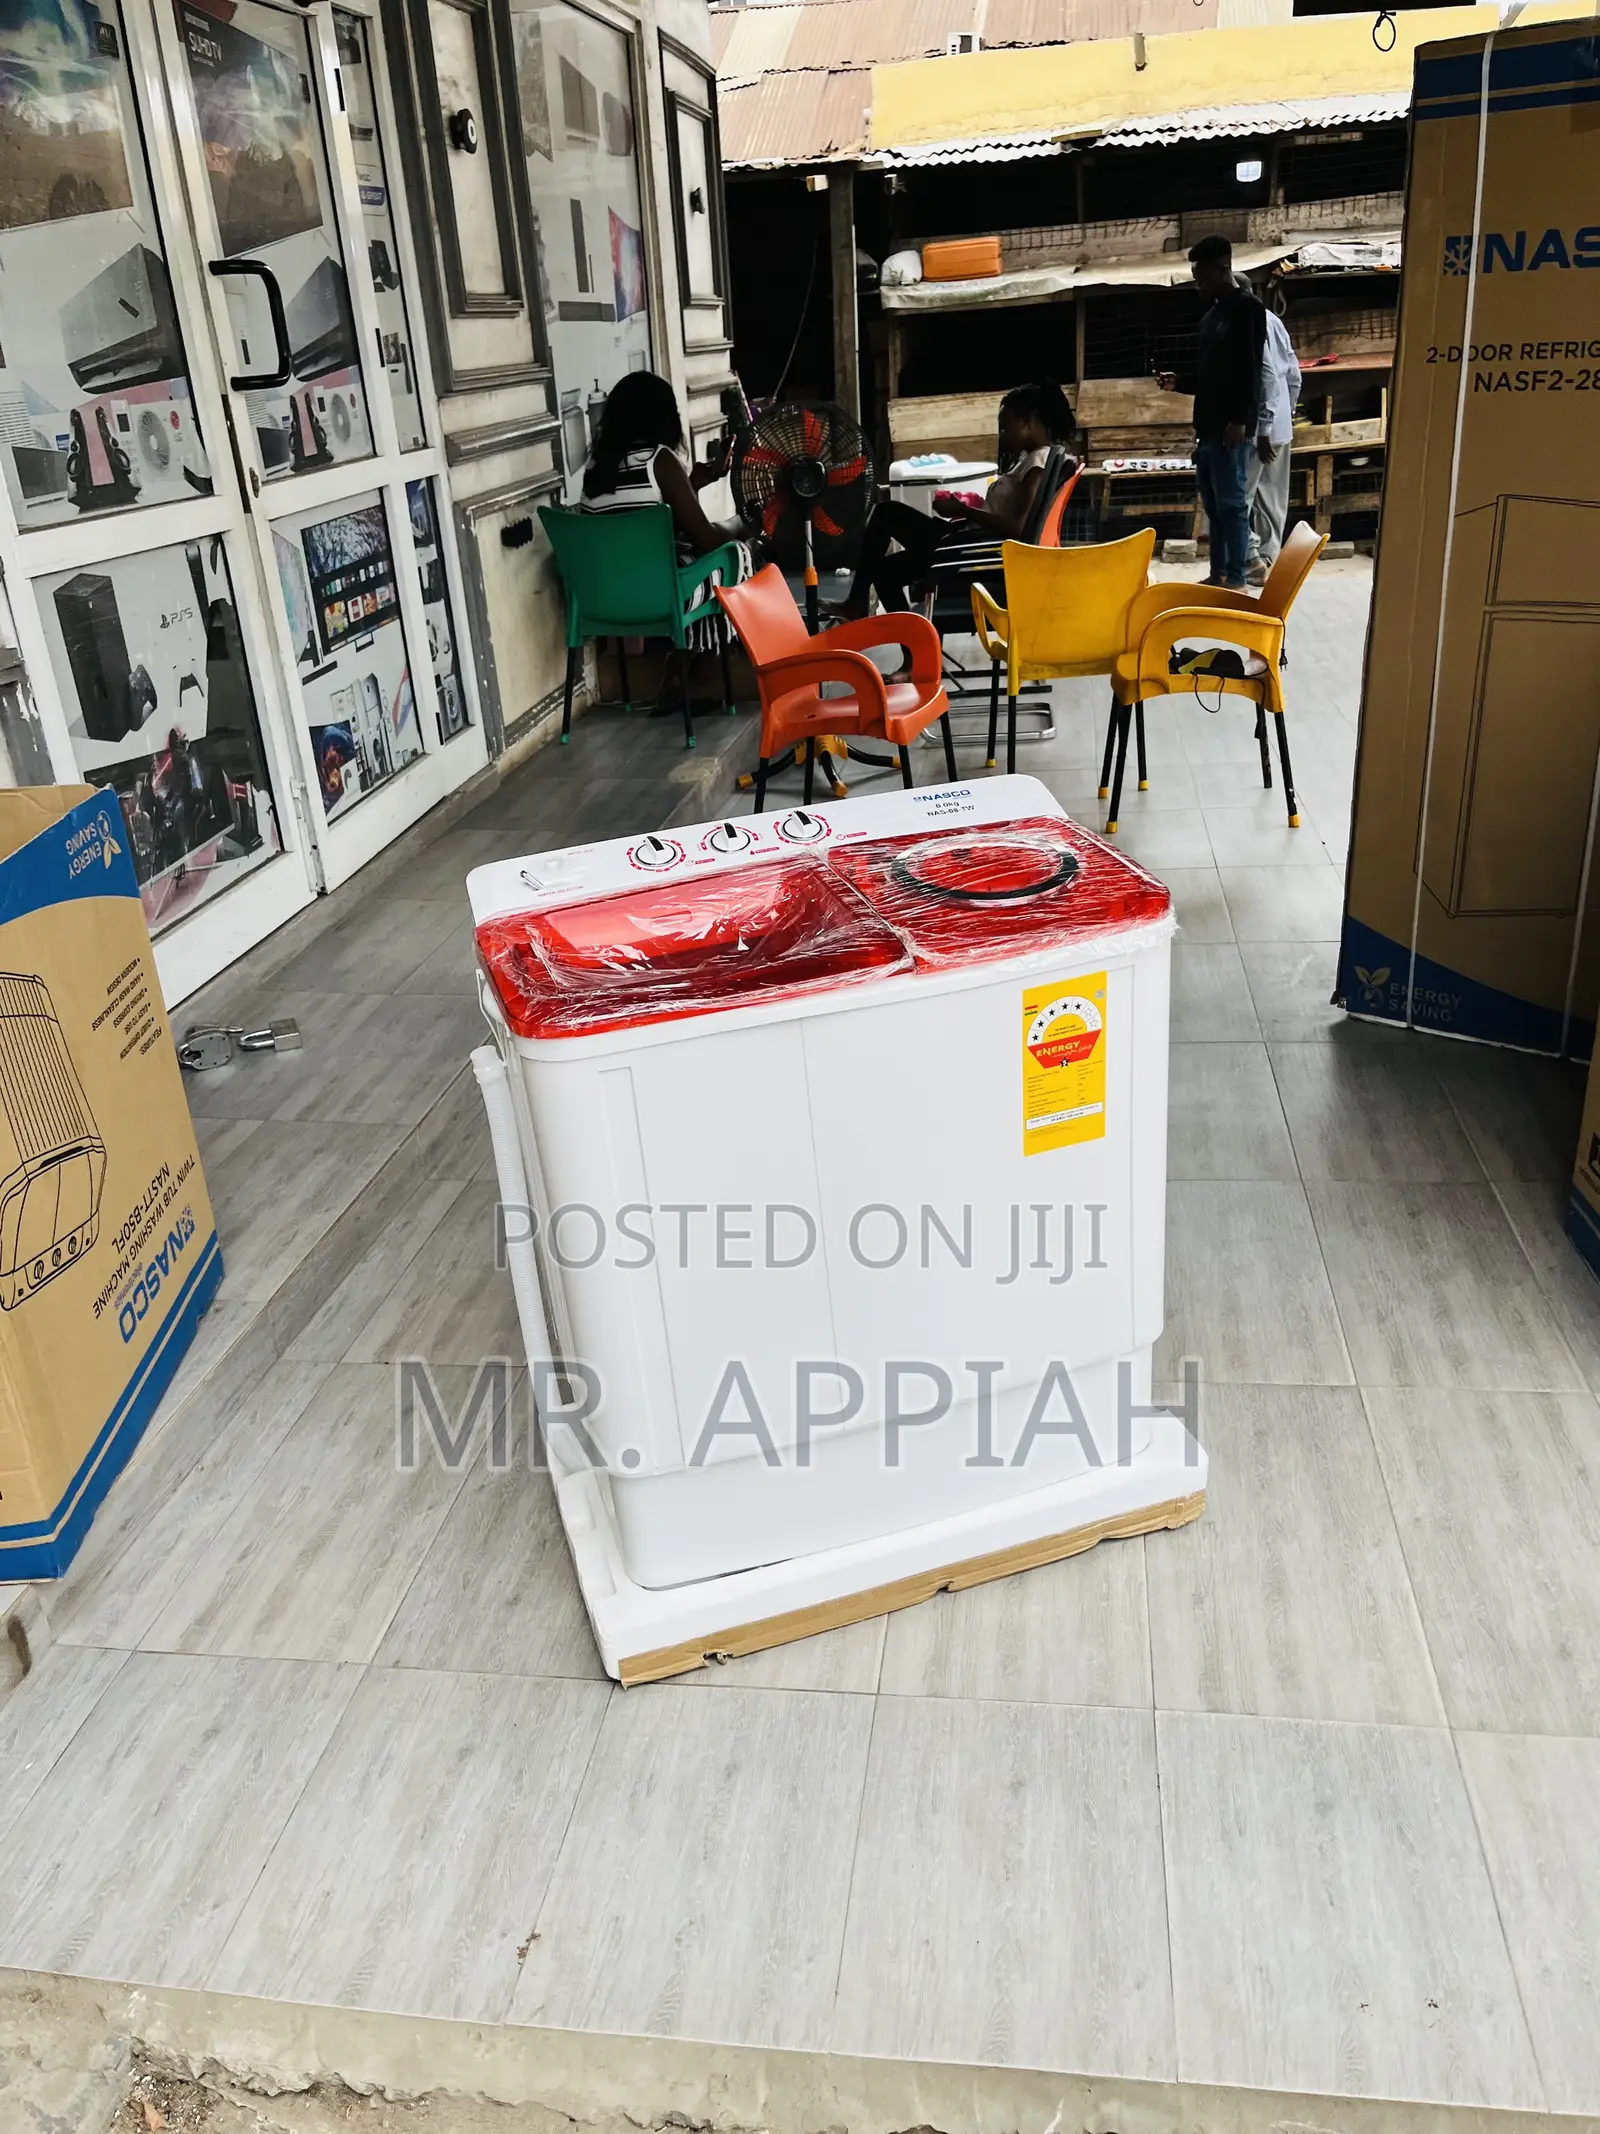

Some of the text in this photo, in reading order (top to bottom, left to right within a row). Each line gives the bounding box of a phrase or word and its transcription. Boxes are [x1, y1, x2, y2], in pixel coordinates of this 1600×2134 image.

[1425, 343, 1513, 364] 2-DOOR
[922, 789, 971, 801] NASCO
[66, 822, 97, 856] SAVING
[68, 841, 102, 880] ENERGY
[1390, 983, 1461, 1008] ENERGY
[138, 1003, 149, 1019] EASY
[1389, 999, 1452, 1022] SAVING
[1036, 1040, 1080, 1057] ENERGY
[92, 1154, 196, 1320] TWIN TUB WASHING MACHINE
[119, 1220, 189, 1344] NASCO
